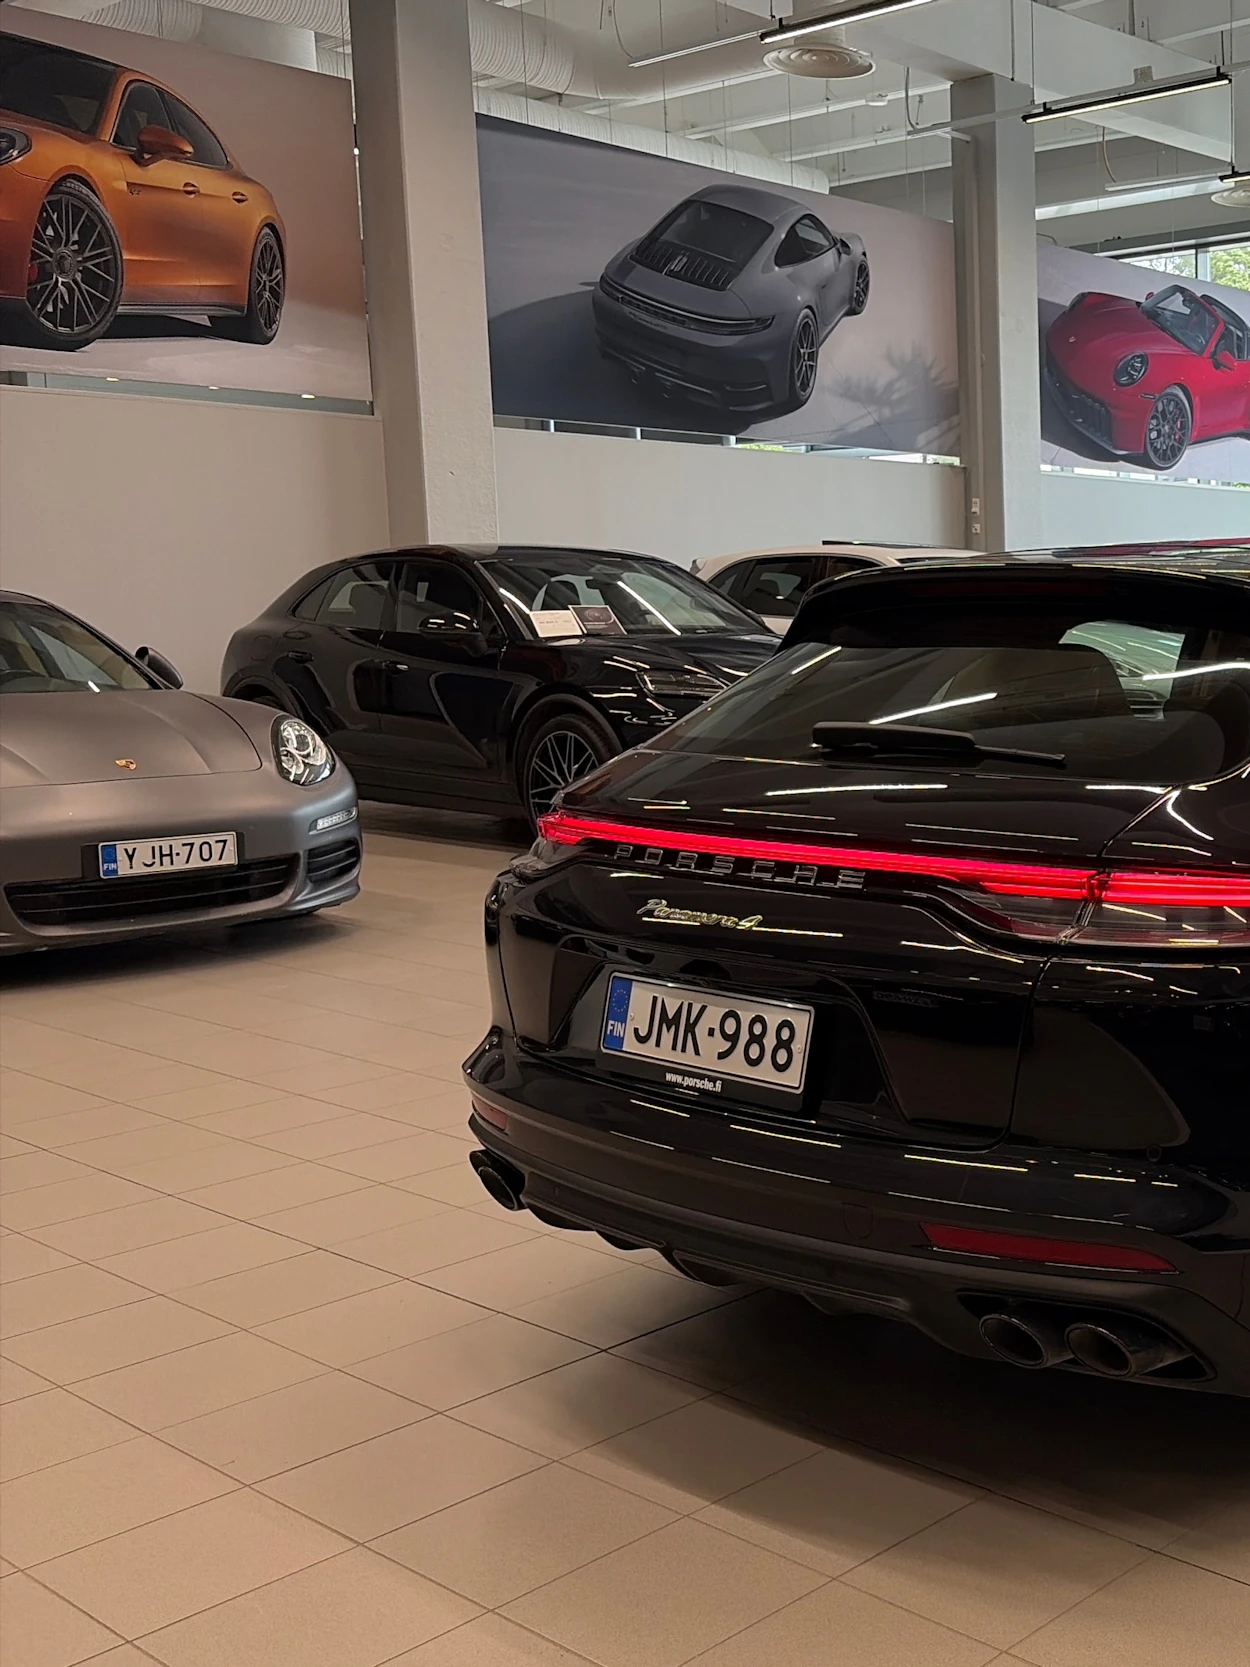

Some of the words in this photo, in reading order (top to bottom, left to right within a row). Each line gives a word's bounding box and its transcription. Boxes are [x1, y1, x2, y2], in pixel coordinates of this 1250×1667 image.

[124, 839, 228, 869] YJH-707
[613, 844, 866, 889] PORSCHE
[607, 1020, 625, 1037] FIN
[634, 995, 795, 1072] JMK-988
[665, 1071, 722, 1093] www.porsche.fi
